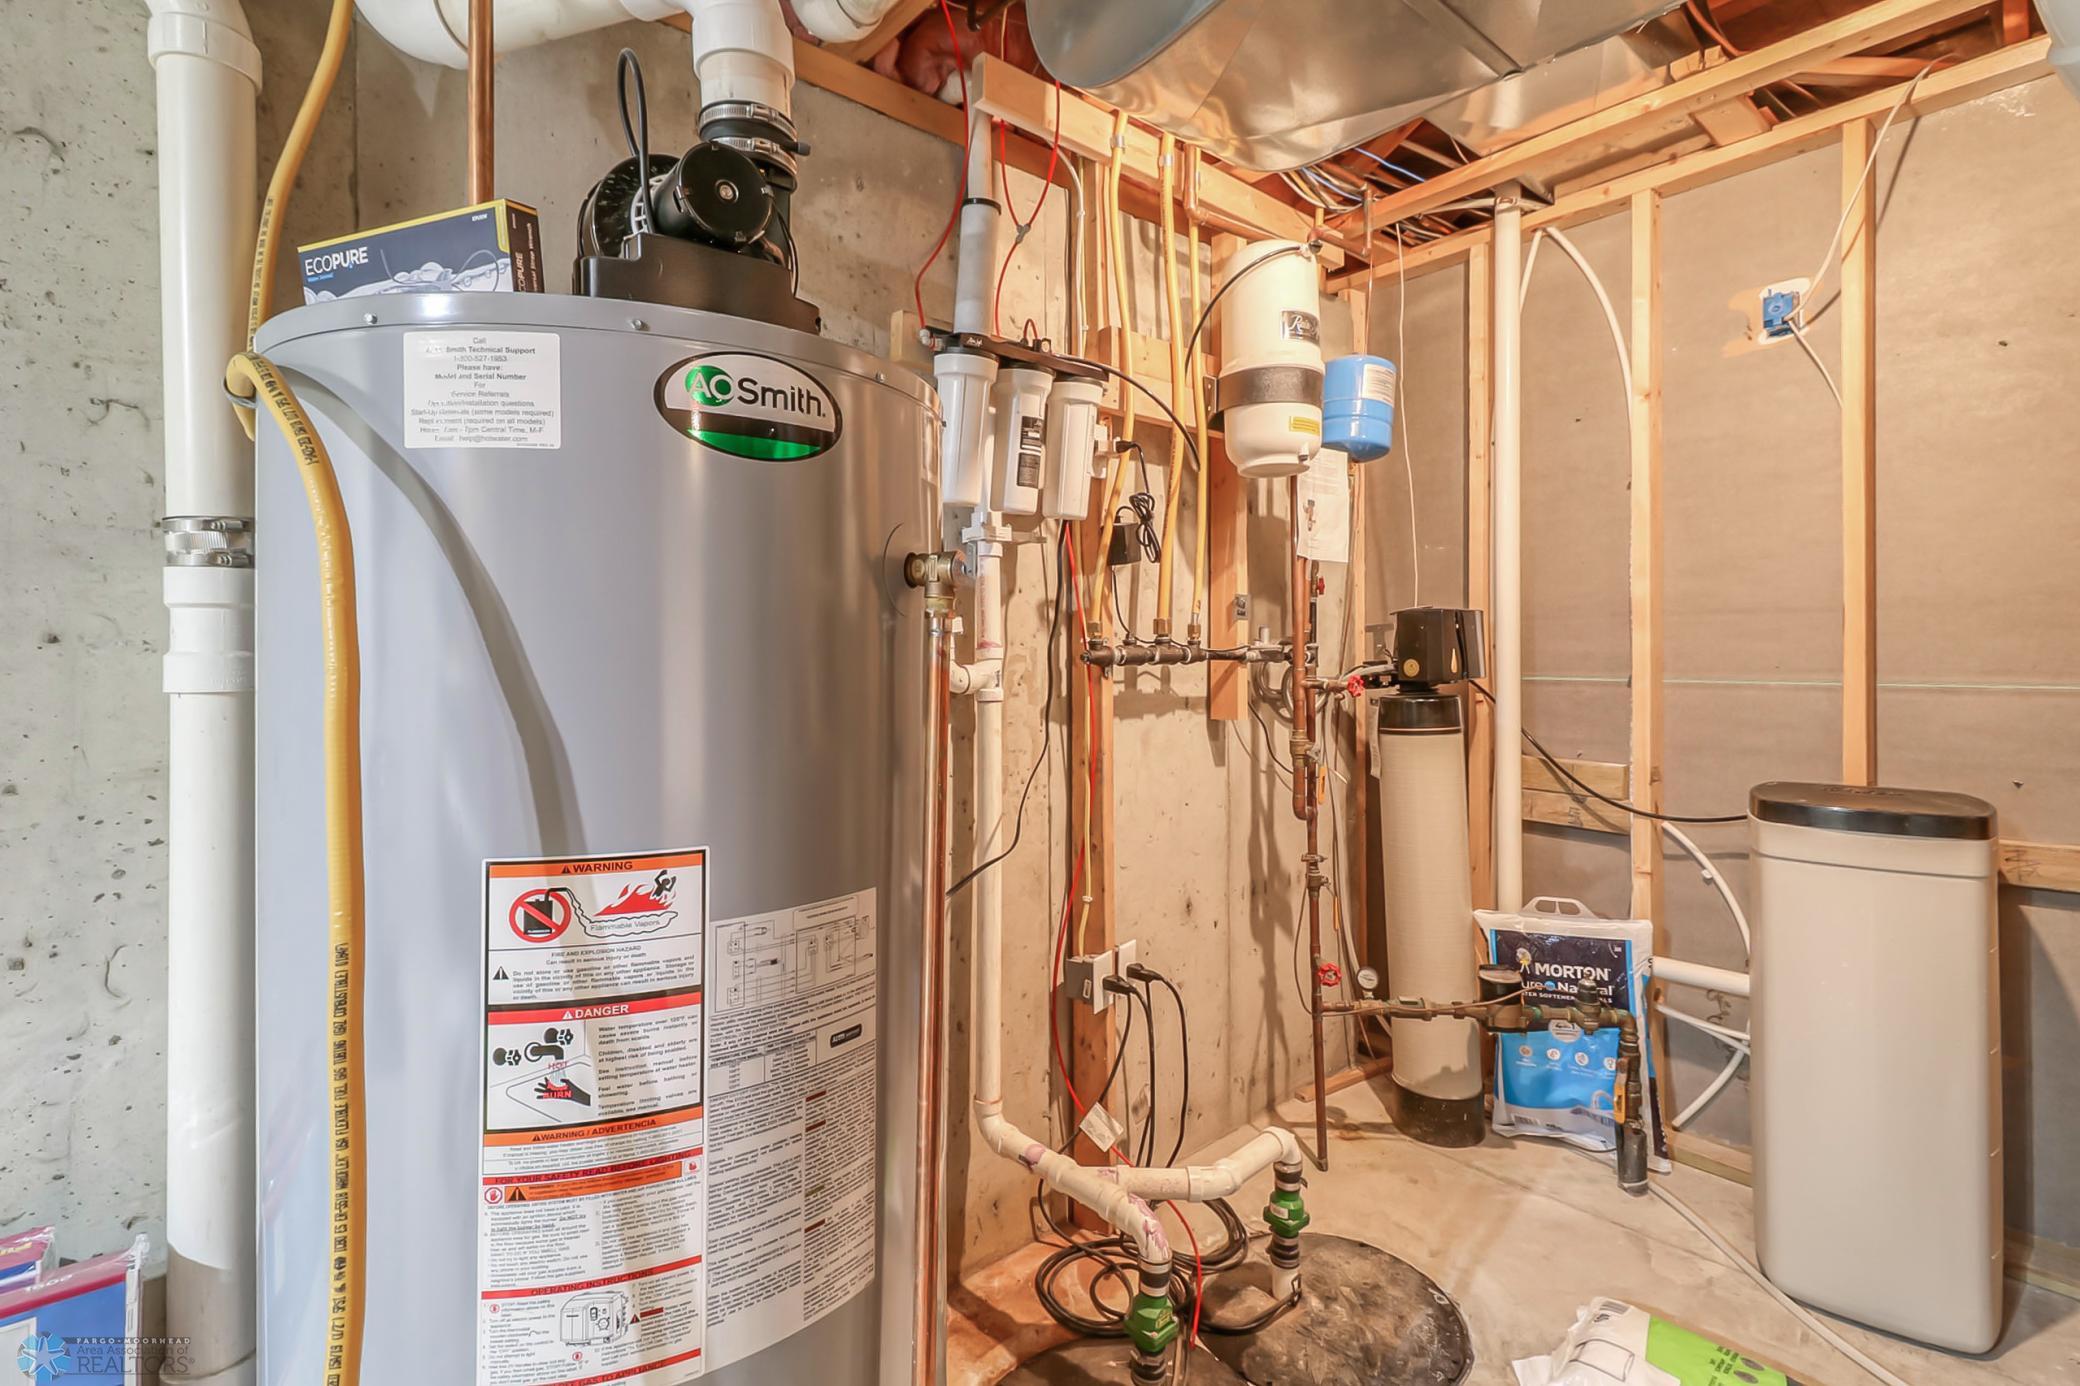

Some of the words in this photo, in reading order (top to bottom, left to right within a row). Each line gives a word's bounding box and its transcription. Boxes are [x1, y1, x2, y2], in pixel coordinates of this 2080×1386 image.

[304, 246, 369, 276] ECOPURE
[515, 251, 526, 291] COPURE
[473, 336, 487, 344] Call
[446, 346, 467, 354] Smith
[468, 346, 503, 354] Technical
[505, 347, 537, 356] Support
[497, 373, 527, 381] Number
[573, 861, 633, 874] WARNING
[590, 922, 632, 932] Flammable
[634, 919, 661, 930] Vapors
[580, 947, 615, 955] EXPLOSION
[1535, 962, 1609, 981] MORTON
[1521, 980, 1544, 990] ure
[575, 1004, 629, 1019] DANGER
[333, 1040, 347, 1066] TUBING
[548, 1060, 569, 1071] HOT
[333, 1067, 347, 1081] GAS
[334, 1083, 348, 1101] FUEL
[335, 1103, 349, 1136] FLEXIBLE
[541, 1130, 585, 1141] WARNING
[591, 1119, 657, 1136] ADVERTENCIA
[335, 1137, 349, 1151] USA
[531, 1282, 581, 1295] OPERATING
[585, 1269, 654, 1288] INSTRUCTIONS
